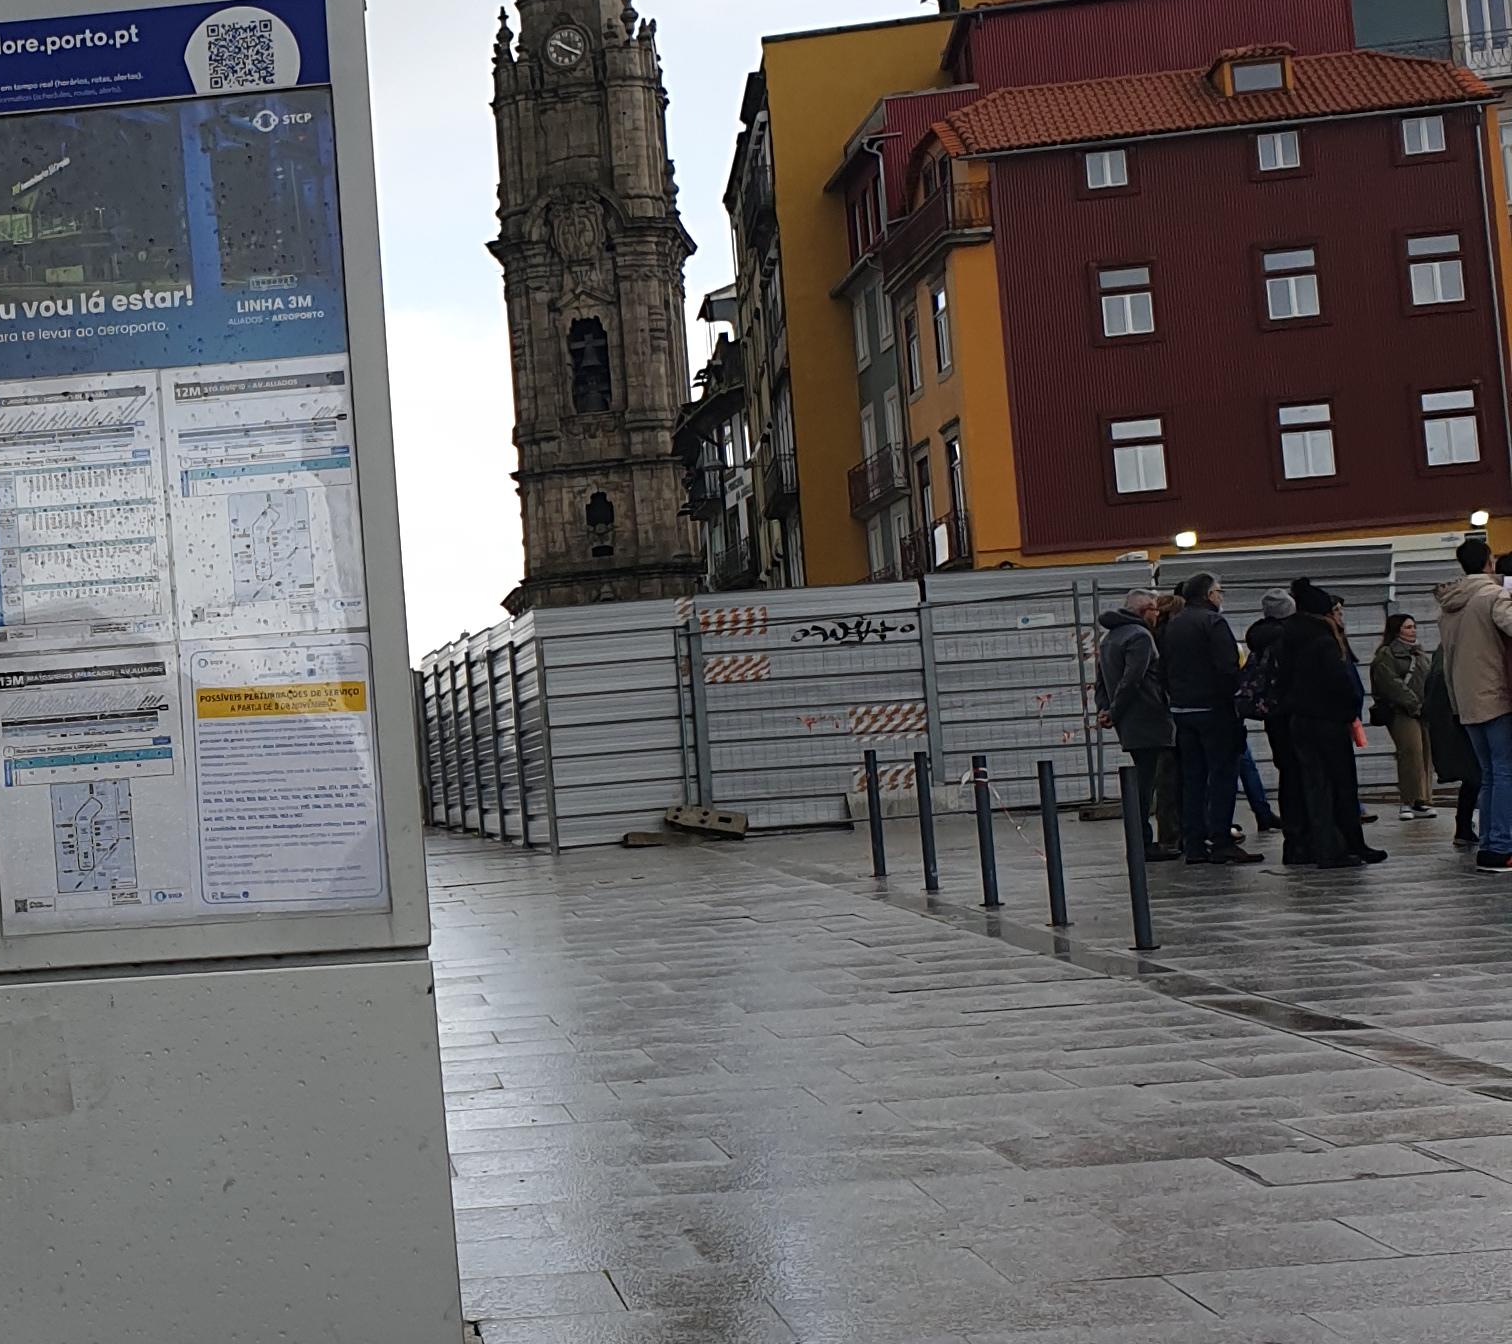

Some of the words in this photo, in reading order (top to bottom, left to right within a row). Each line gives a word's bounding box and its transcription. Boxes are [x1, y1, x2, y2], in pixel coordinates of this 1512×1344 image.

[281, 112, 312, 125] STCP
[22, 296, 74, 318] vou
[80, 289, 106, 314] lá
[111, 283, 194, 312] estar!
[236, 296, 284, 314] LINHA
[288, 293, 313, 310] 3M
[227, 315, 263, 327] ALIADOS
[271, 310, 325, 323] AEROPORTO
[21, 327, 35, 342] te
[38, 323, 72, 340] levar
[75, 326, 94, 338] ao
[97, 320, 169, 340] aeroporto.
[175, 386, 201, 399] 12M
